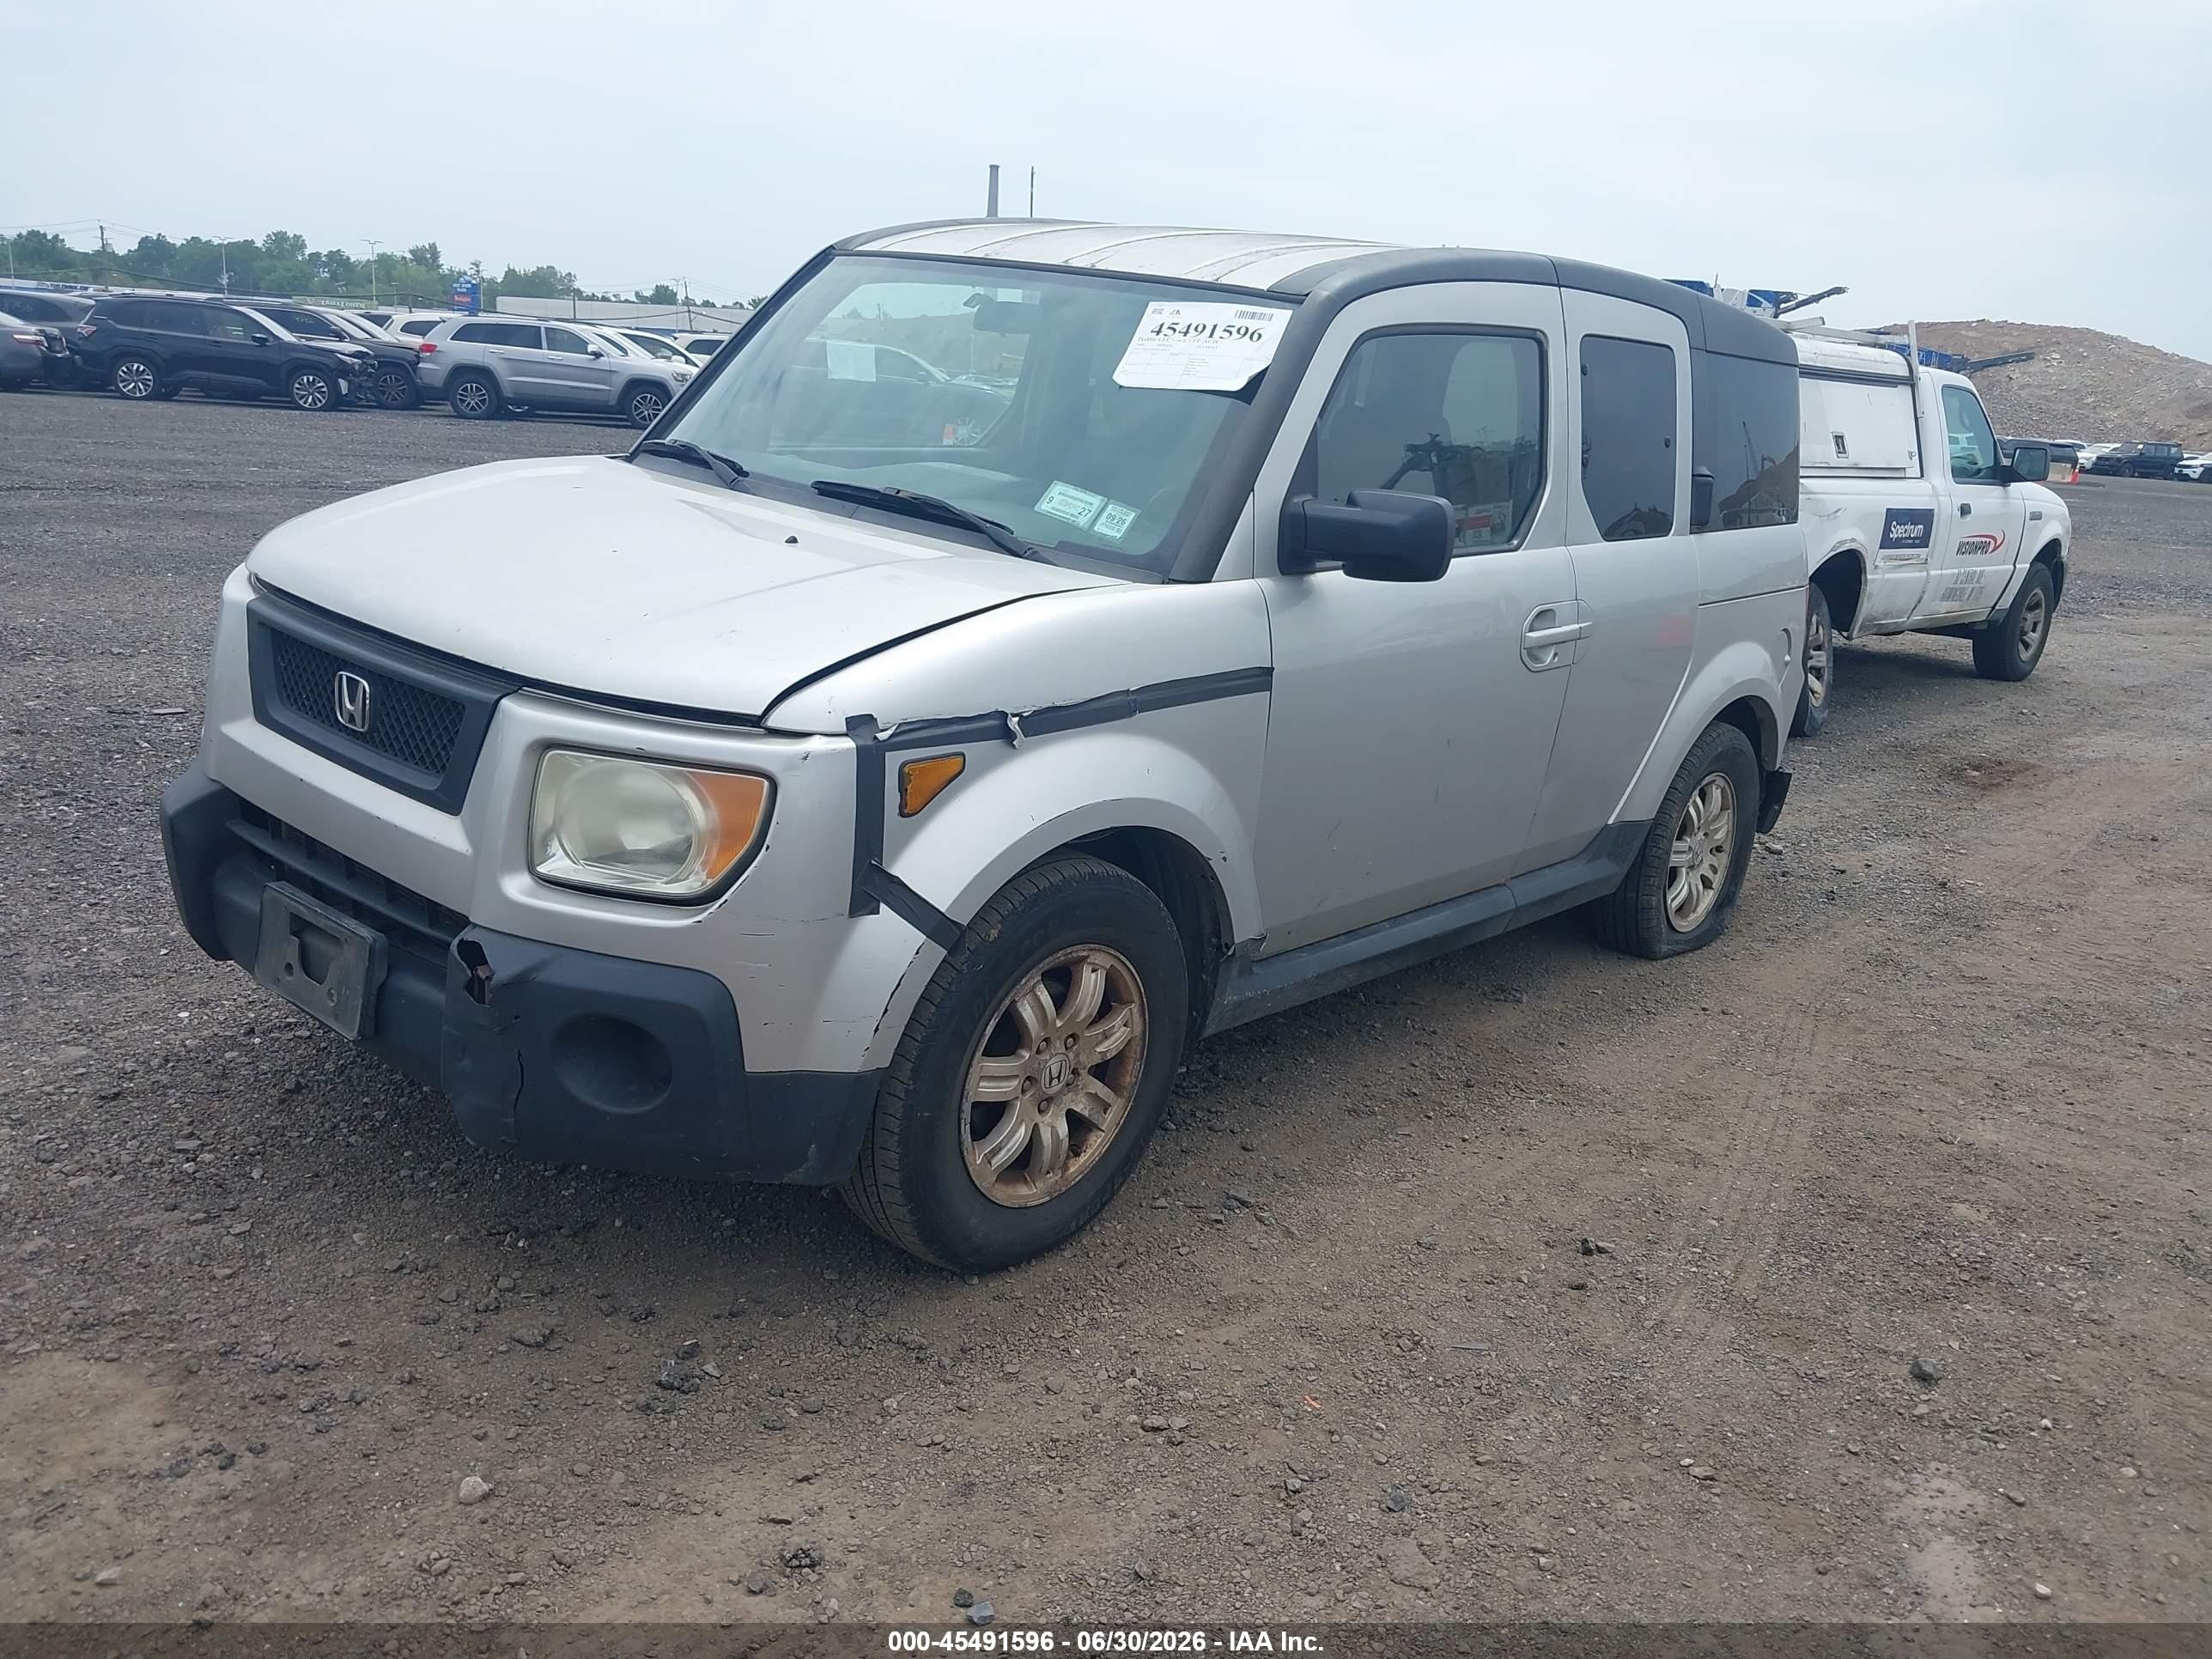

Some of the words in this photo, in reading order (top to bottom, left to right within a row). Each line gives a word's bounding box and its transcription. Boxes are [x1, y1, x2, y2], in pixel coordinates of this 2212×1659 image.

[1151, 321, 1265, 343] 45491596
[1047, 496, 1054, 505] 9
[1078, 507, 1091, 518] 27
[1889, 521, 1924, 542] Spectrum
[1956, 540, 1991, 556] VISIONPRO
